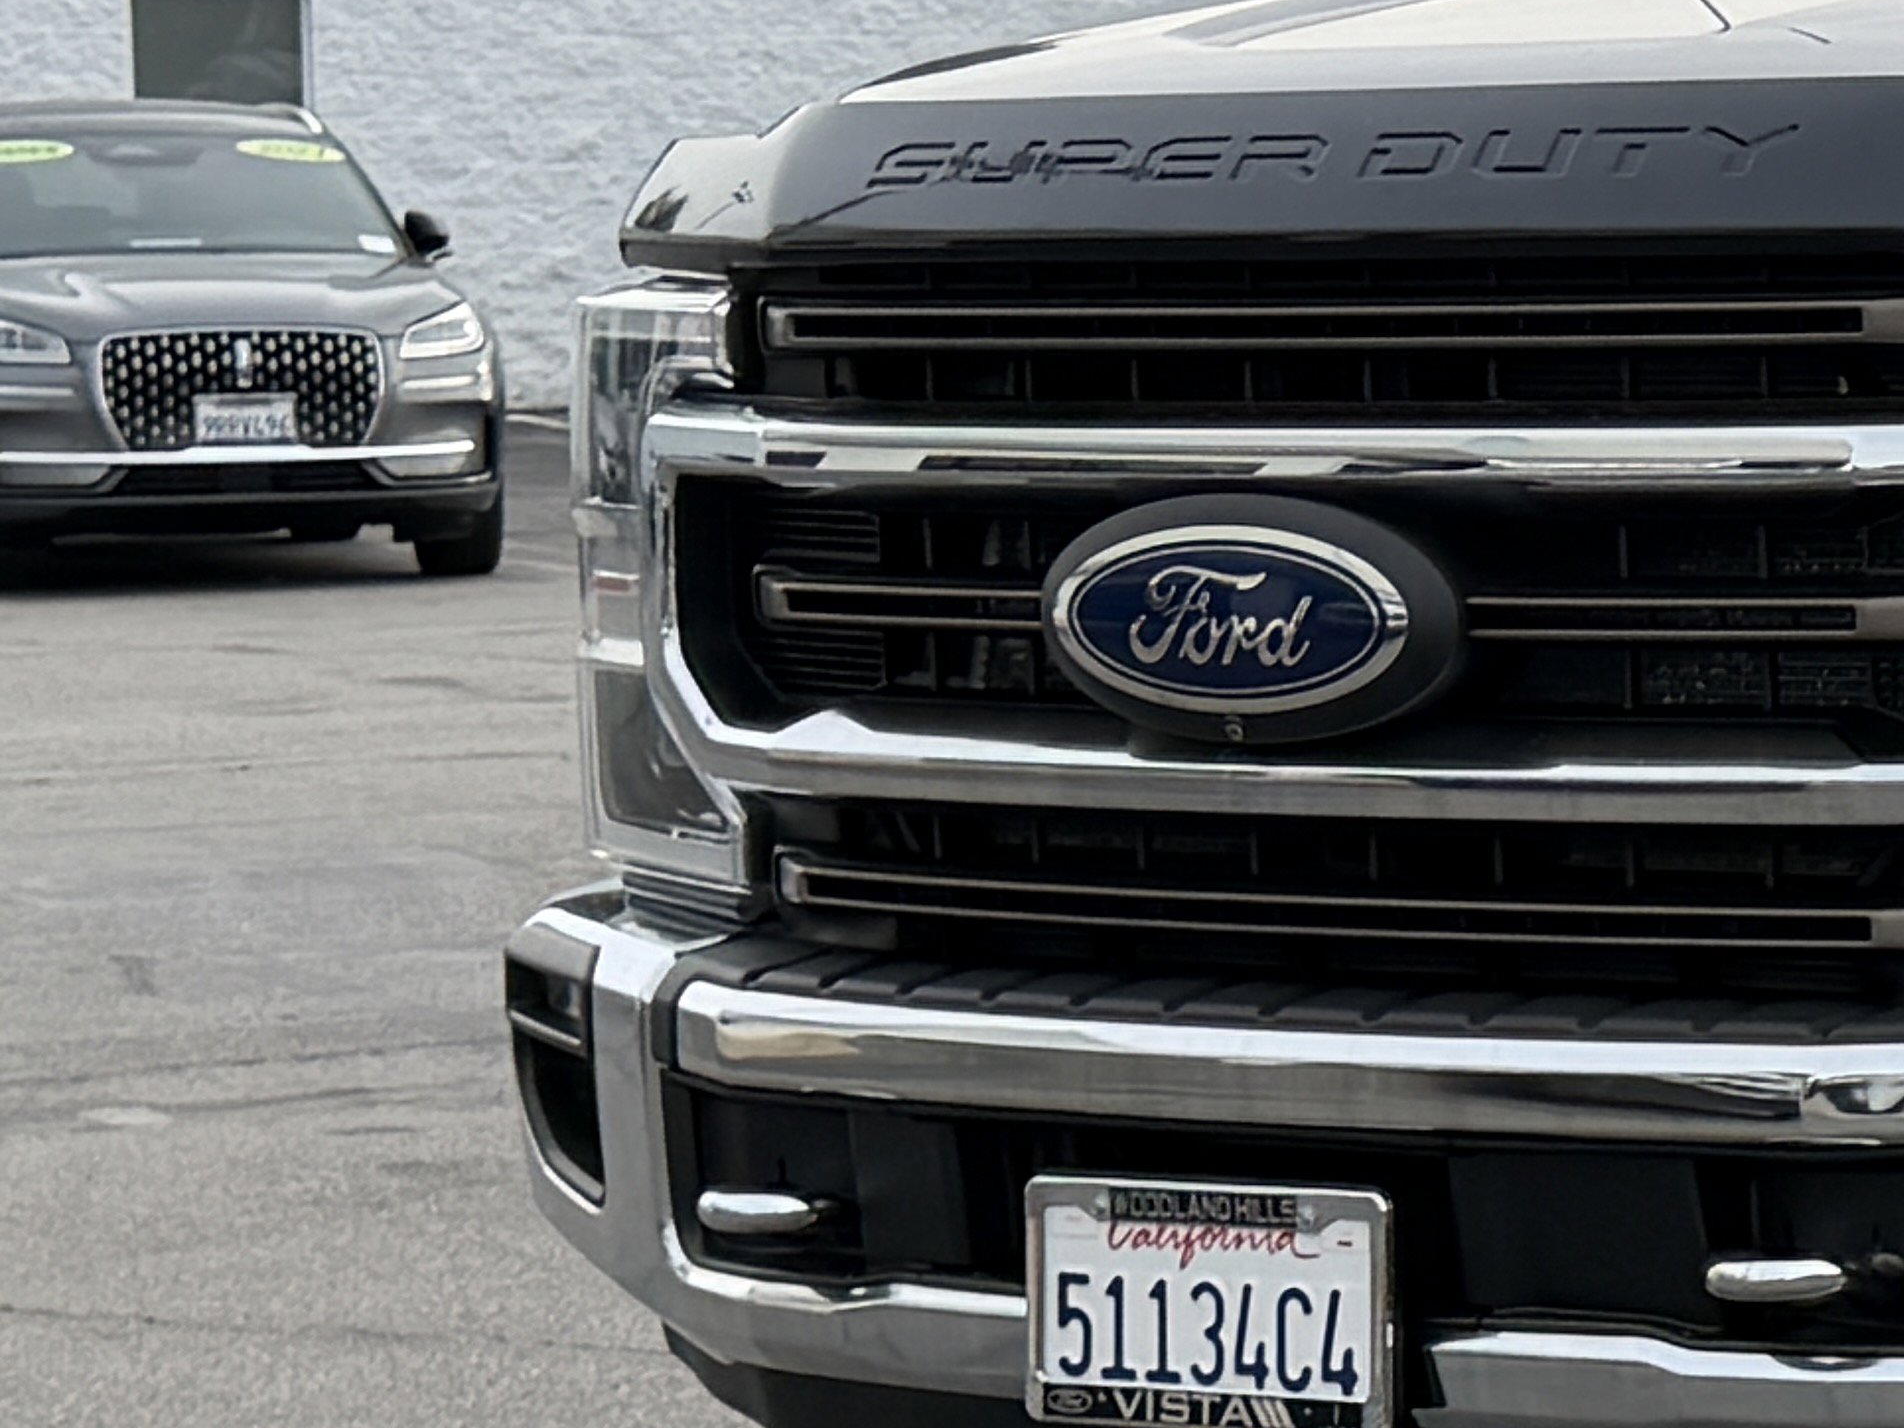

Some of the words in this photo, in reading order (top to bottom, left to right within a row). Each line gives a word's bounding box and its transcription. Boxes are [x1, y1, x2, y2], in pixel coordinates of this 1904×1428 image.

[866, 134, 1329, 189] SUPER
[1357, 123, 1800, 181] DUTY
[1128, 564, 1315, 668] Ford
[1108, 1219, 1321, 1271] California
[1057, 1271, 1359, 1396] 51134C4
